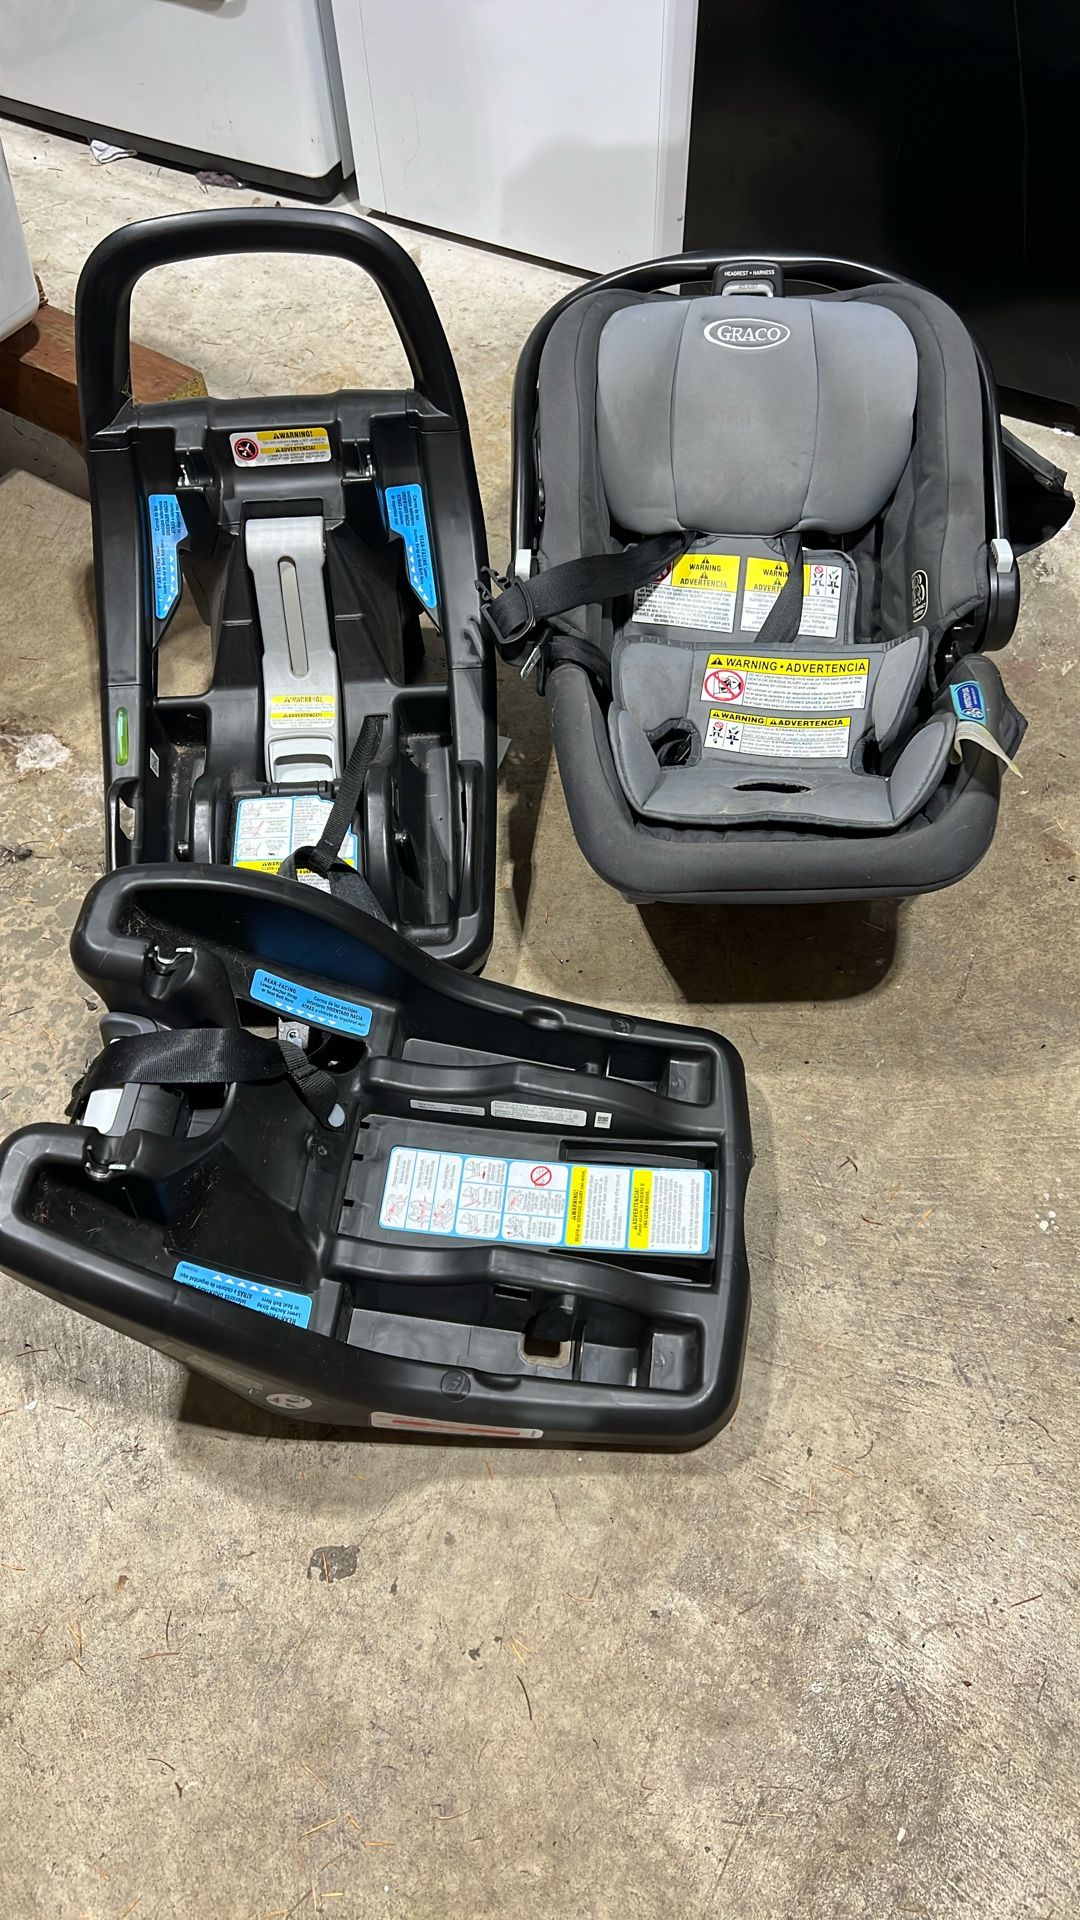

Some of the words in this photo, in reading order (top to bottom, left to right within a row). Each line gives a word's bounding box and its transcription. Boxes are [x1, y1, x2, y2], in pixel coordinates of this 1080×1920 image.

[717, 325, 781, 342] GRACO
[279, 430, 313, 439] WARNING!
[689, 563, 721, 572] WARNING
[763, 569, 790, 577] WARNIN
[680, 578, 727, 588] ADVERTENCIA
[726, 658, 777, 671] WARNING
[786, 662, 866, 673] ADVERTENCIA
[721, 712, 764, 724] WARNING
[263, 976, 298, 994] REAR-FACING
[349, 1012, 364, 1022] HACIA
[571, 1189, 579, 1216] WARNING!
[256, 1301, 271, 1311] Strap
